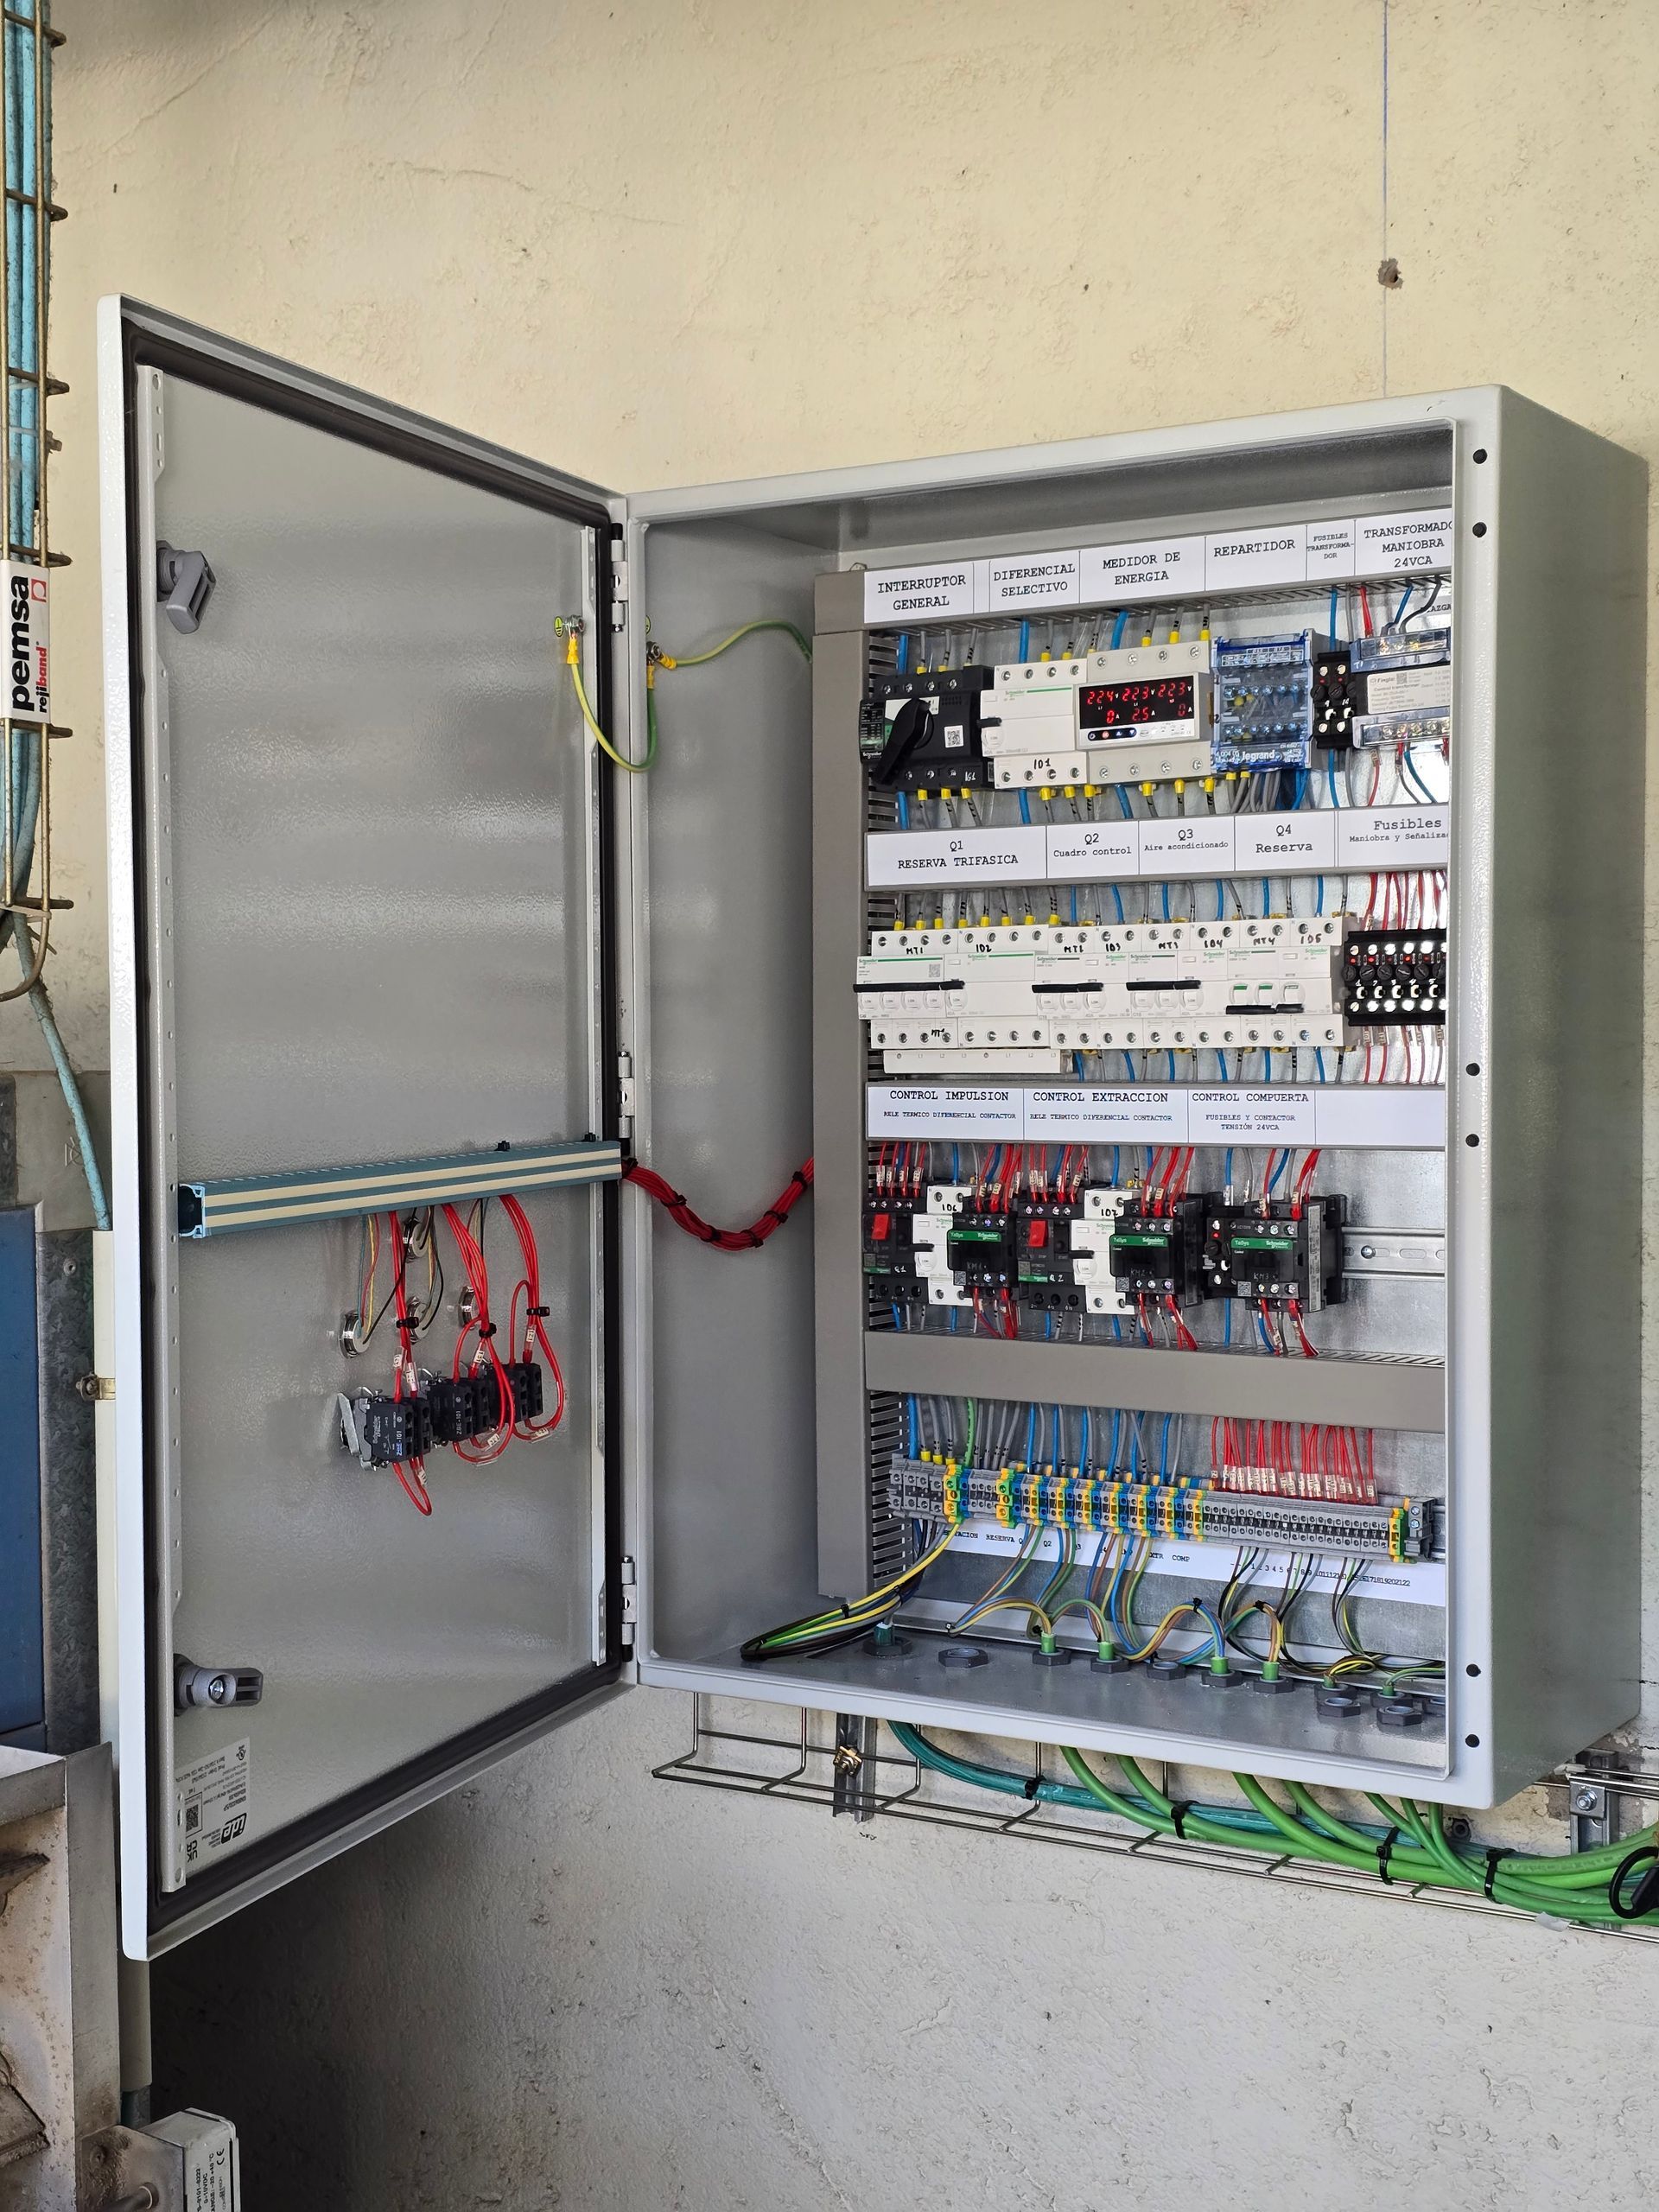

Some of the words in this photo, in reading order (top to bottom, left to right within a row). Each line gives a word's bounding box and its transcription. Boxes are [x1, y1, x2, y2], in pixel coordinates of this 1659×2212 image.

[1313, 532, 1348, 542] FUSIBLES
[1214, 539, 1295, 557] REPARTIDOR
[1382, 538, 1445, 553] MANIOBRA
[1103, 555, 1157, 569] MEDIDOR
[1165, 552, 1180, 563] DE
[1394, 556, 1433, 568] 24VCA
[994, 564, 1075, 582] DIFERENCIAL
[1115, 570, 1169, 585] ENERGIA
[877, 575, 966, 594] INTERRUPTOR
[1001, 582, 1067, 597] SELECTIVO
[893, 596, 950, 610] GENERAL
[10, 575, 35, 711] pemsa
[35, 645, 49, 713] rejiband
[1087, 691, 1114, 705] 224
[1122, 686, 1149, 702] 223
[1158, 682, 1185, 697] 223
[1107, 710, 1115, 724] 0
[1178, 703, 1185, 716] 0
[1276, 824, 1292, 836] Q4
[1374, 818, 1442, 831] Fusibles
[1084, 833, 1099, 845] Q2
[1178, 829, 1193, 841] Q3
[1350, 834, 1389, 842] Maniobra
[950, 841, 963, 851] Q1
[1053, 849, 1087, 857] Cuadro
[1093, 846, 1132, 855] control
[1167, 841, 1229, 850] acondicionado
[1255, 842, 1313, 854] Reserva
[898, 859, 947, 869] RESERVA
[954, 855, 1019, 867] TRIFASICA
[890, 1090, 938, 1100] CONTROL
[945, 1092, 1008, 1101] IMPULSION
[1033, 1092, 1084, 1102] CONTROL
[1092, 1093, 1168, 1103] EXTRACCION
[1192, 1093, 1239, 1102] CONTROL
[1246, 1093, 1309, 1102] COMPUERTA
